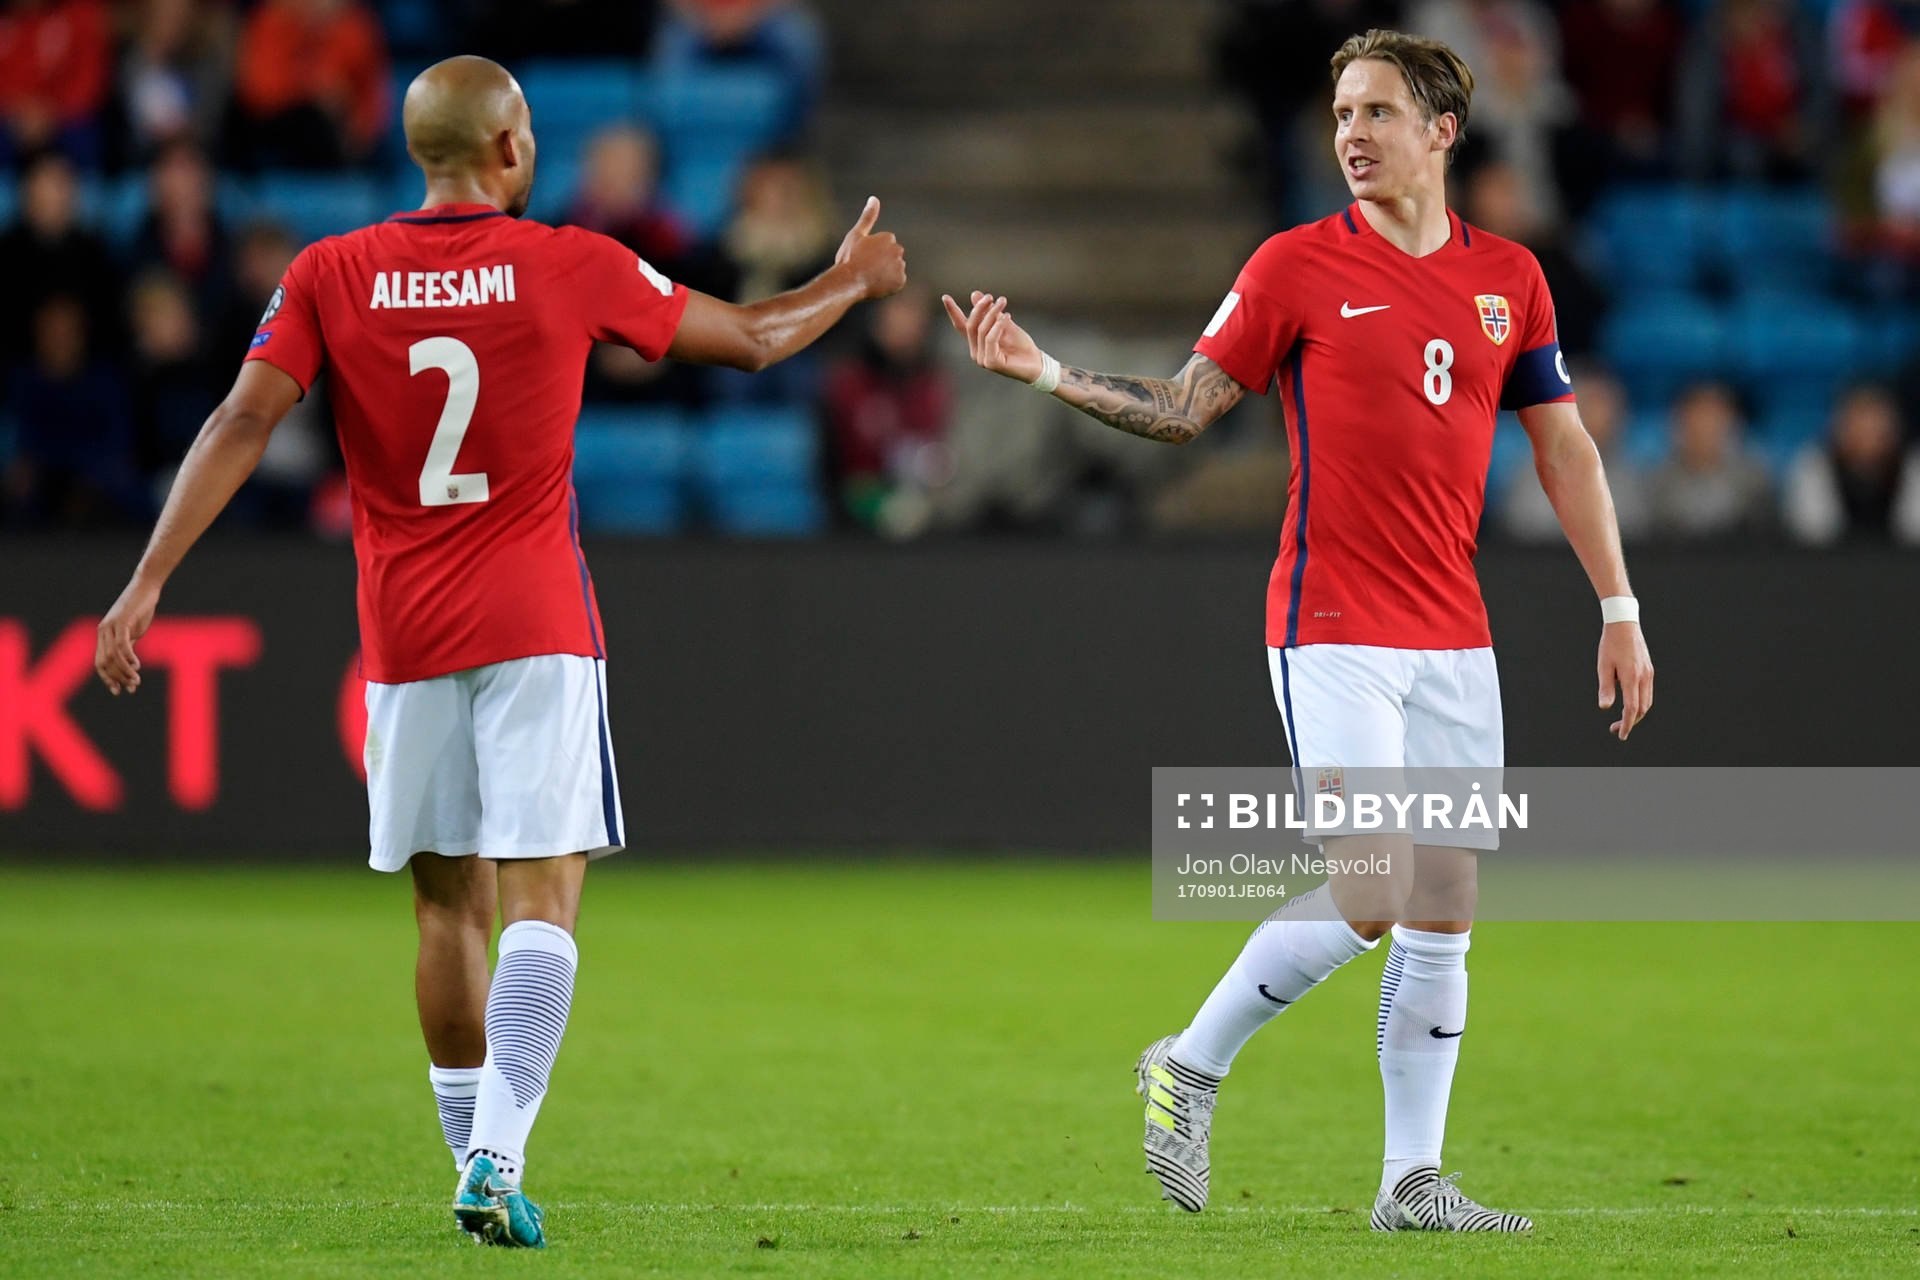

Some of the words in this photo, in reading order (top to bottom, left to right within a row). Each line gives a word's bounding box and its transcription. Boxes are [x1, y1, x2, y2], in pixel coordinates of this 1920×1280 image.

[369, 264, 517, 310] ALEESAMI
[1423, 338, 1454, 406] 8
[408, 336, 490, 507] 2
